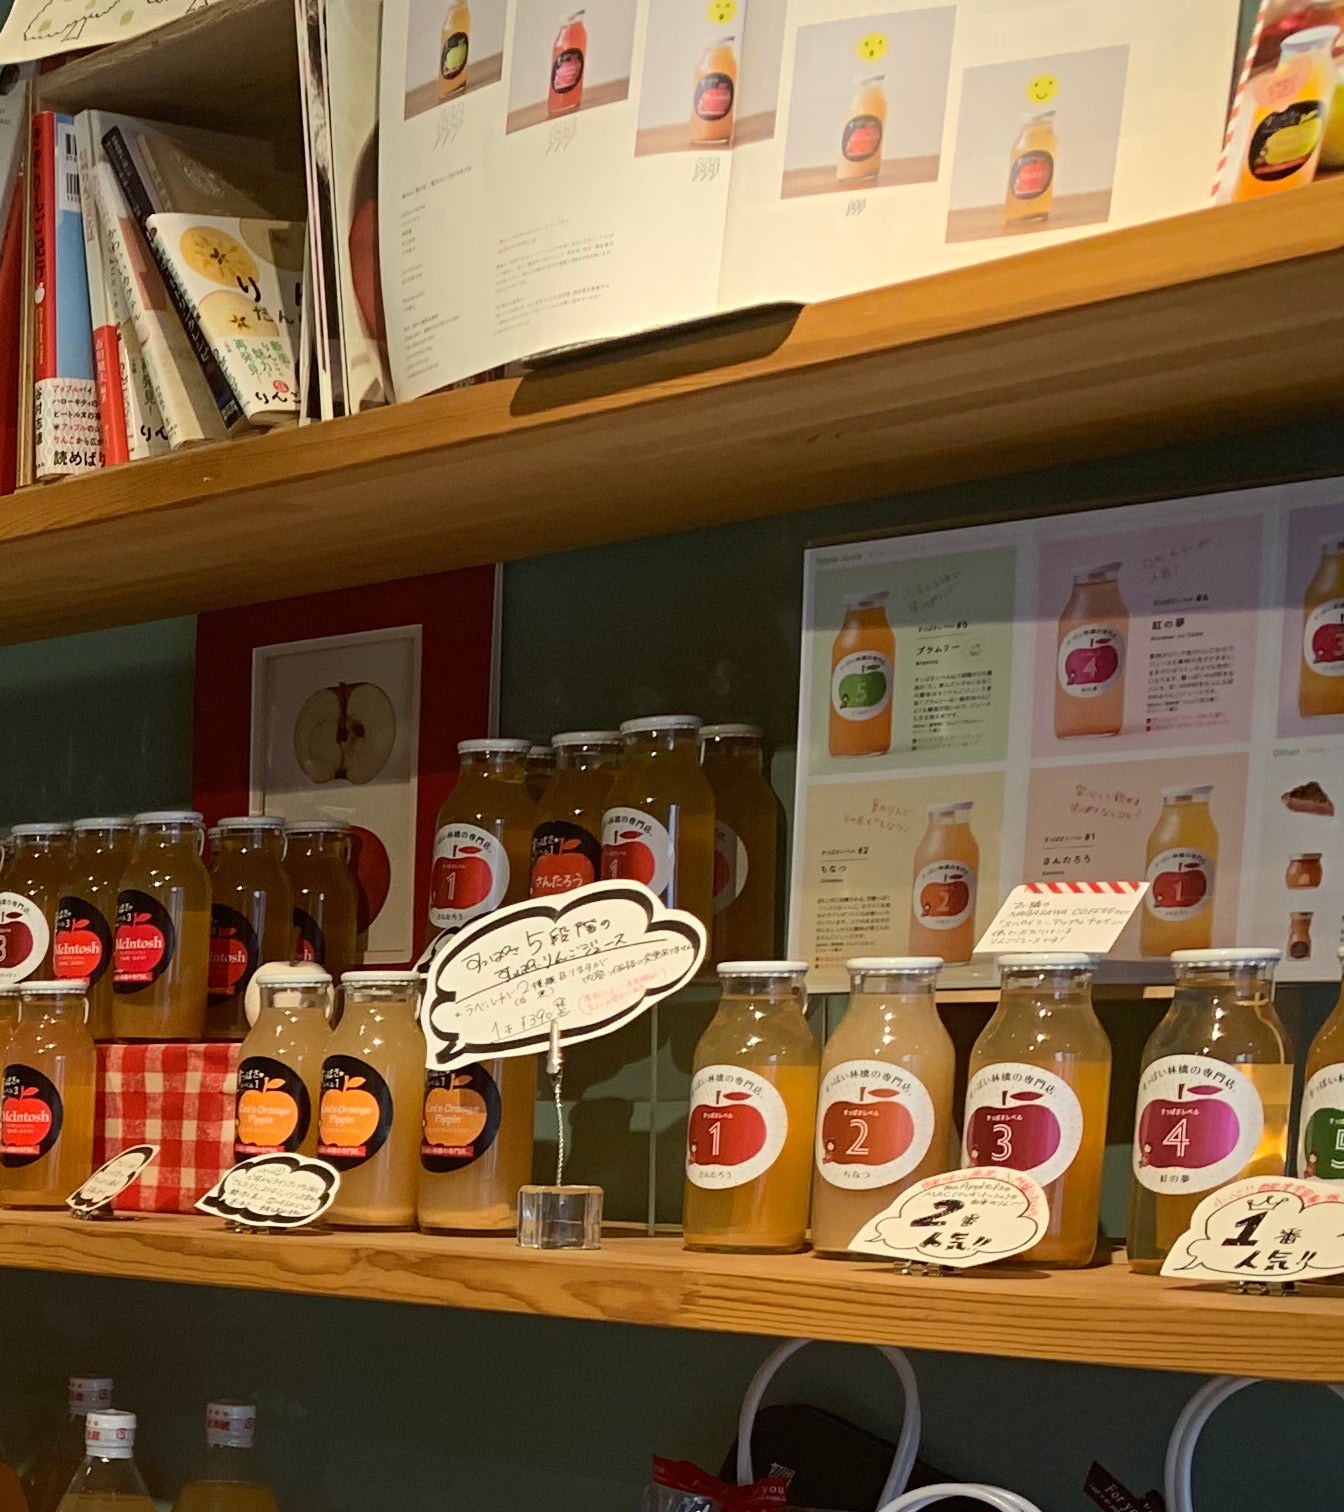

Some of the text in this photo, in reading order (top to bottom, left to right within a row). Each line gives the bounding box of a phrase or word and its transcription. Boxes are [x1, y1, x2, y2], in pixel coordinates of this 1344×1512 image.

[446, 871, 457, 901] 1
[534, 872, 585, 889] さんたろう
[708, 1120, 722, 1157] 1
[845, 1118, 871, 1156] 2
[990, 1123, 1013, 1162] 3
[1161, 1117, 1191, 1158] 4
[1159, 1174, 1191, 1184] 紅の夢
[1104, 1483, 1125, 1510] For
